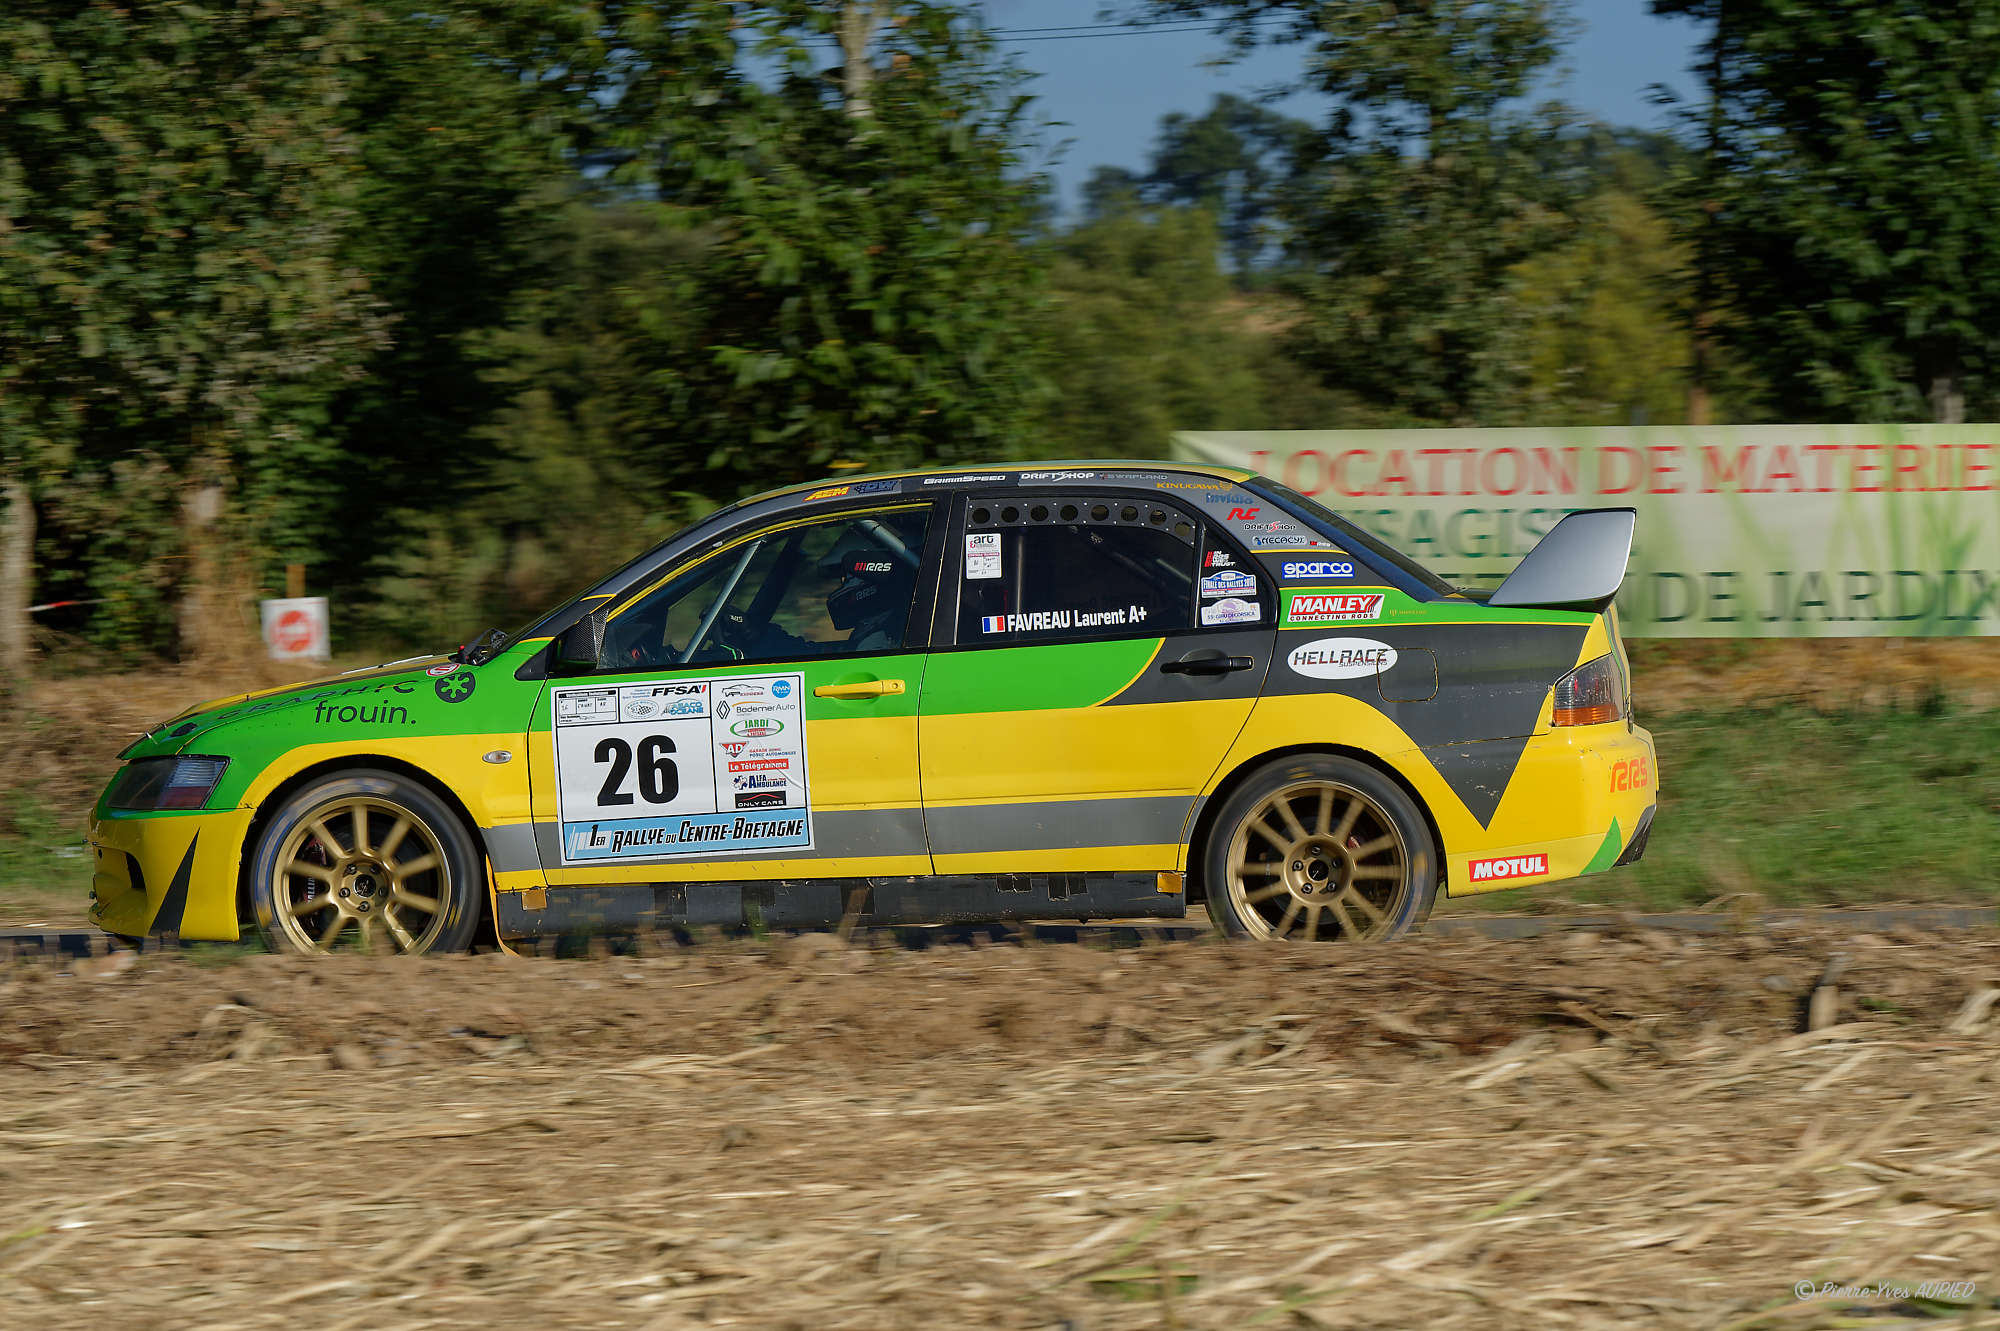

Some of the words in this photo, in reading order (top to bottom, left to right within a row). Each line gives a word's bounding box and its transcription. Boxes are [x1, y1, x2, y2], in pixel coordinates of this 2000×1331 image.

[1593, 446, 1686, 494] DE
[1697, 444, 2000, 493] MATERIE
[866, 563, 892, 571] RRS
[1284, 562, 1353, 578] sparco
[1292, 595, 1371, 613] MANLEY
[1648, 571, 1741, 623] DE
[1007, 611, 1071, 632] FAVREAU
[1074, 607, 1126, 627] Laurent
[1128, 605, 1147, 624] A+
[1293, 648, 1389, 666] HELLRACE
[652, 685, 700, 697] FFSA
[314, 699, 417, 724] frouin.
[728, 743, 743, 754] AD
[594, 735, 679, 806] 26
[741, 761, 787, 772] Télégramme
[1610, 756, 1648, 793] RRS
[611, 828, 666, 853] RALLYE
[665, 833, 677, 844] DU
[679, 817, 804, 843] CENTRE-BRETAGNE
[1473, 857, 1545, 879] MOTUL
